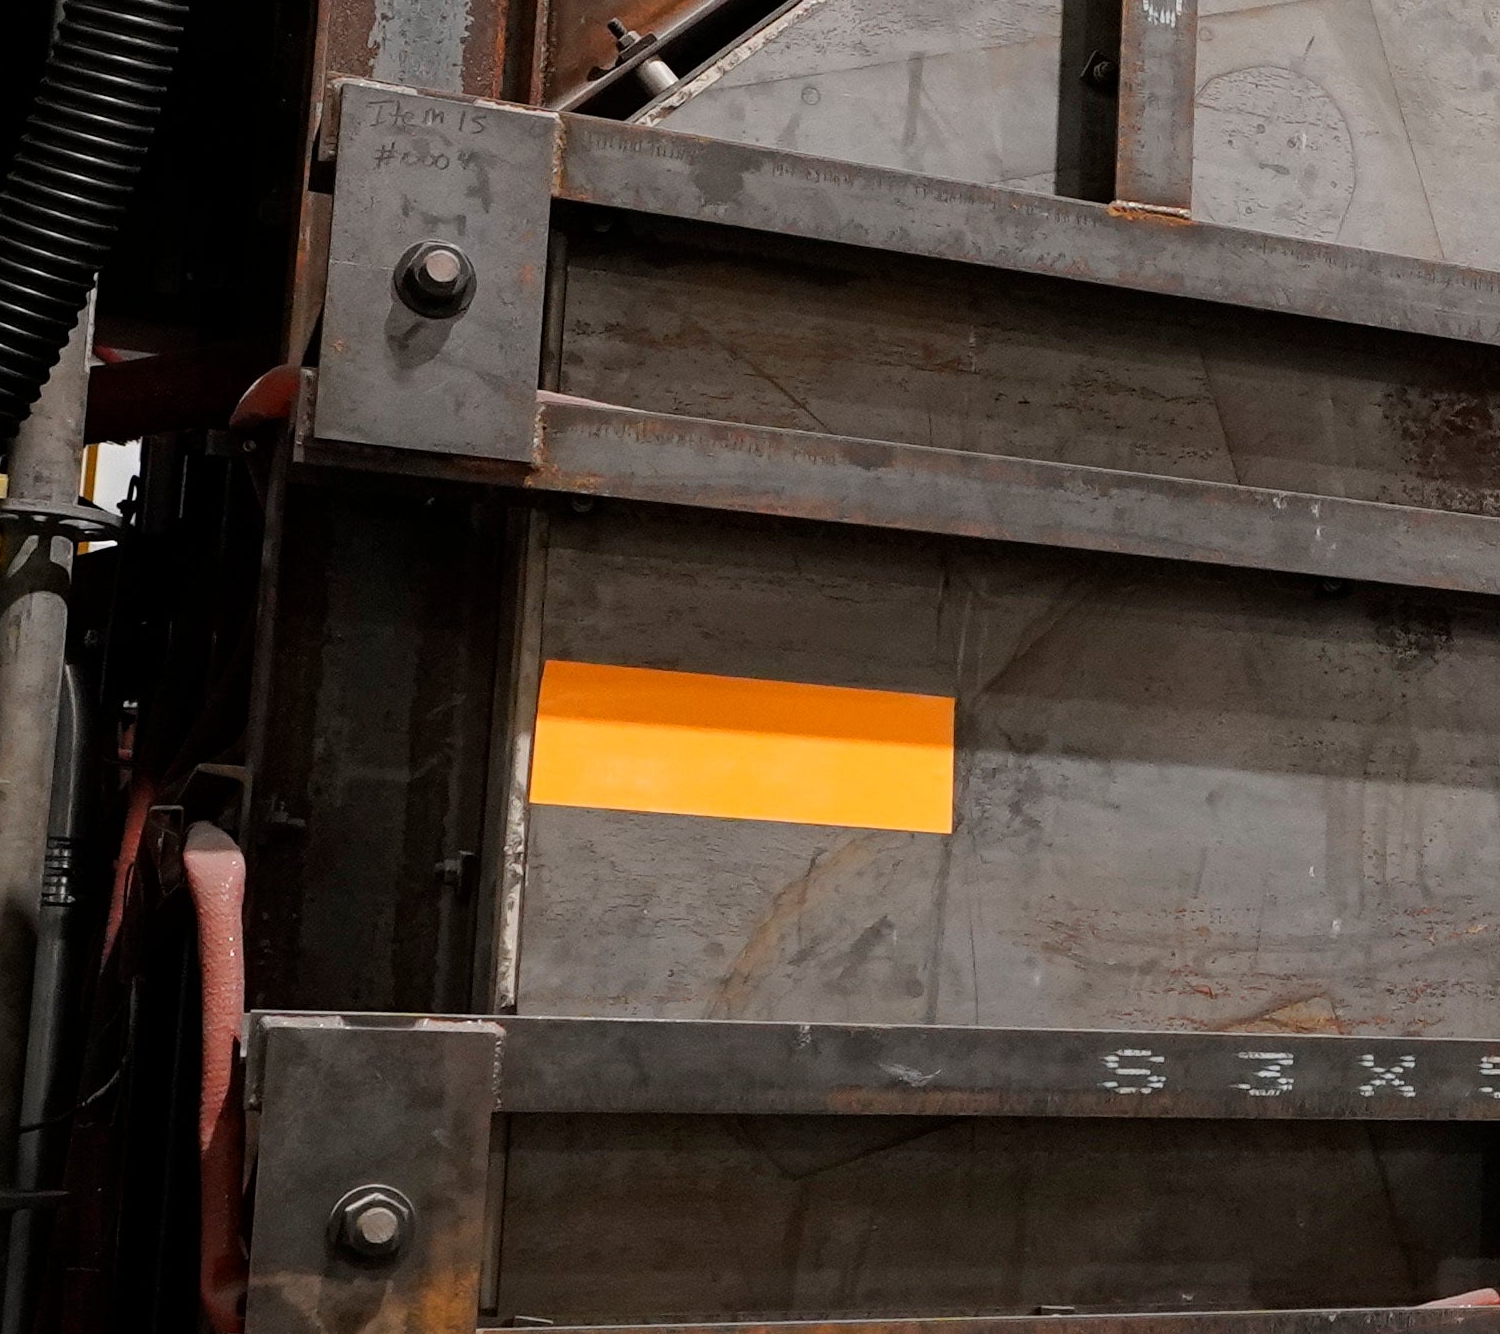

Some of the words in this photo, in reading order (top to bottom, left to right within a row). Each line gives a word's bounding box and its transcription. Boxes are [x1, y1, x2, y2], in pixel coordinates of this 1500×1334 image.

[368, 100, 444, 127] Item
[1098, 1047, 1165, 1097] S
[1230, 1050, 1294, 1097] 3
[1357, 1053, 1417, 1099] X
